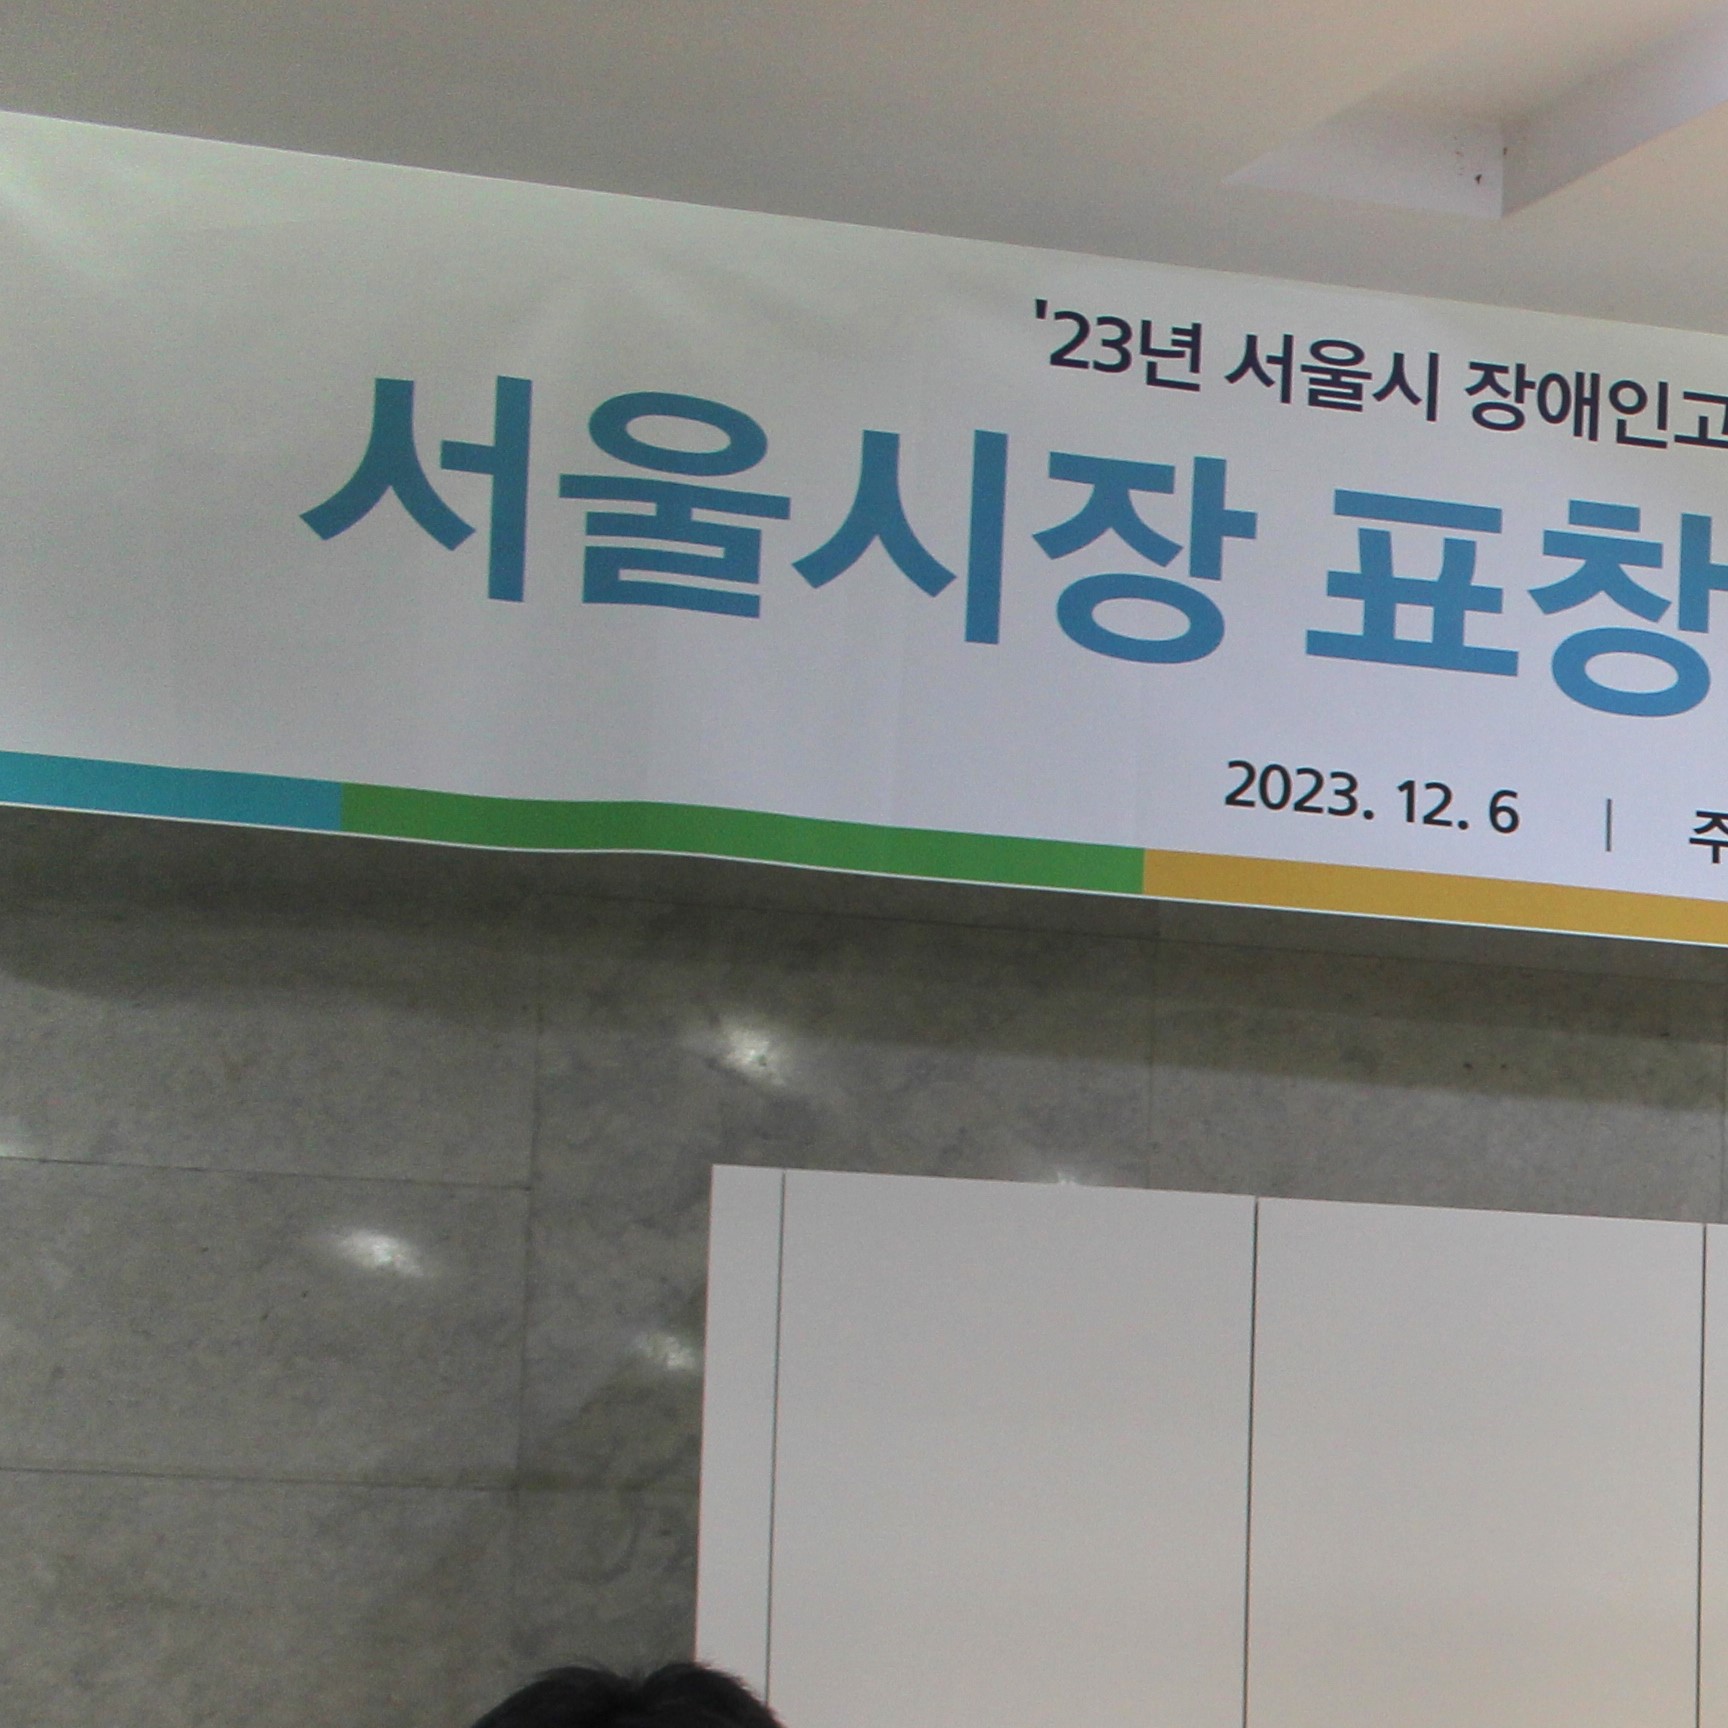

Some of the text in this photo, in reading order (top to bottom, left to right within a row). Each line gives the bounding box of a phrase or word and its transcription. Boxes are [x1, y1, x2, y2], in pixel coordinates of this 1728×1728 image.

[1034, 299, 1203, 392] '23년
[1225, 333, 1440, 422] 서울시
[299, 374, 1257, 664] 서울시장
[1224, 760, 1521, 834] 2023. 12. 6
